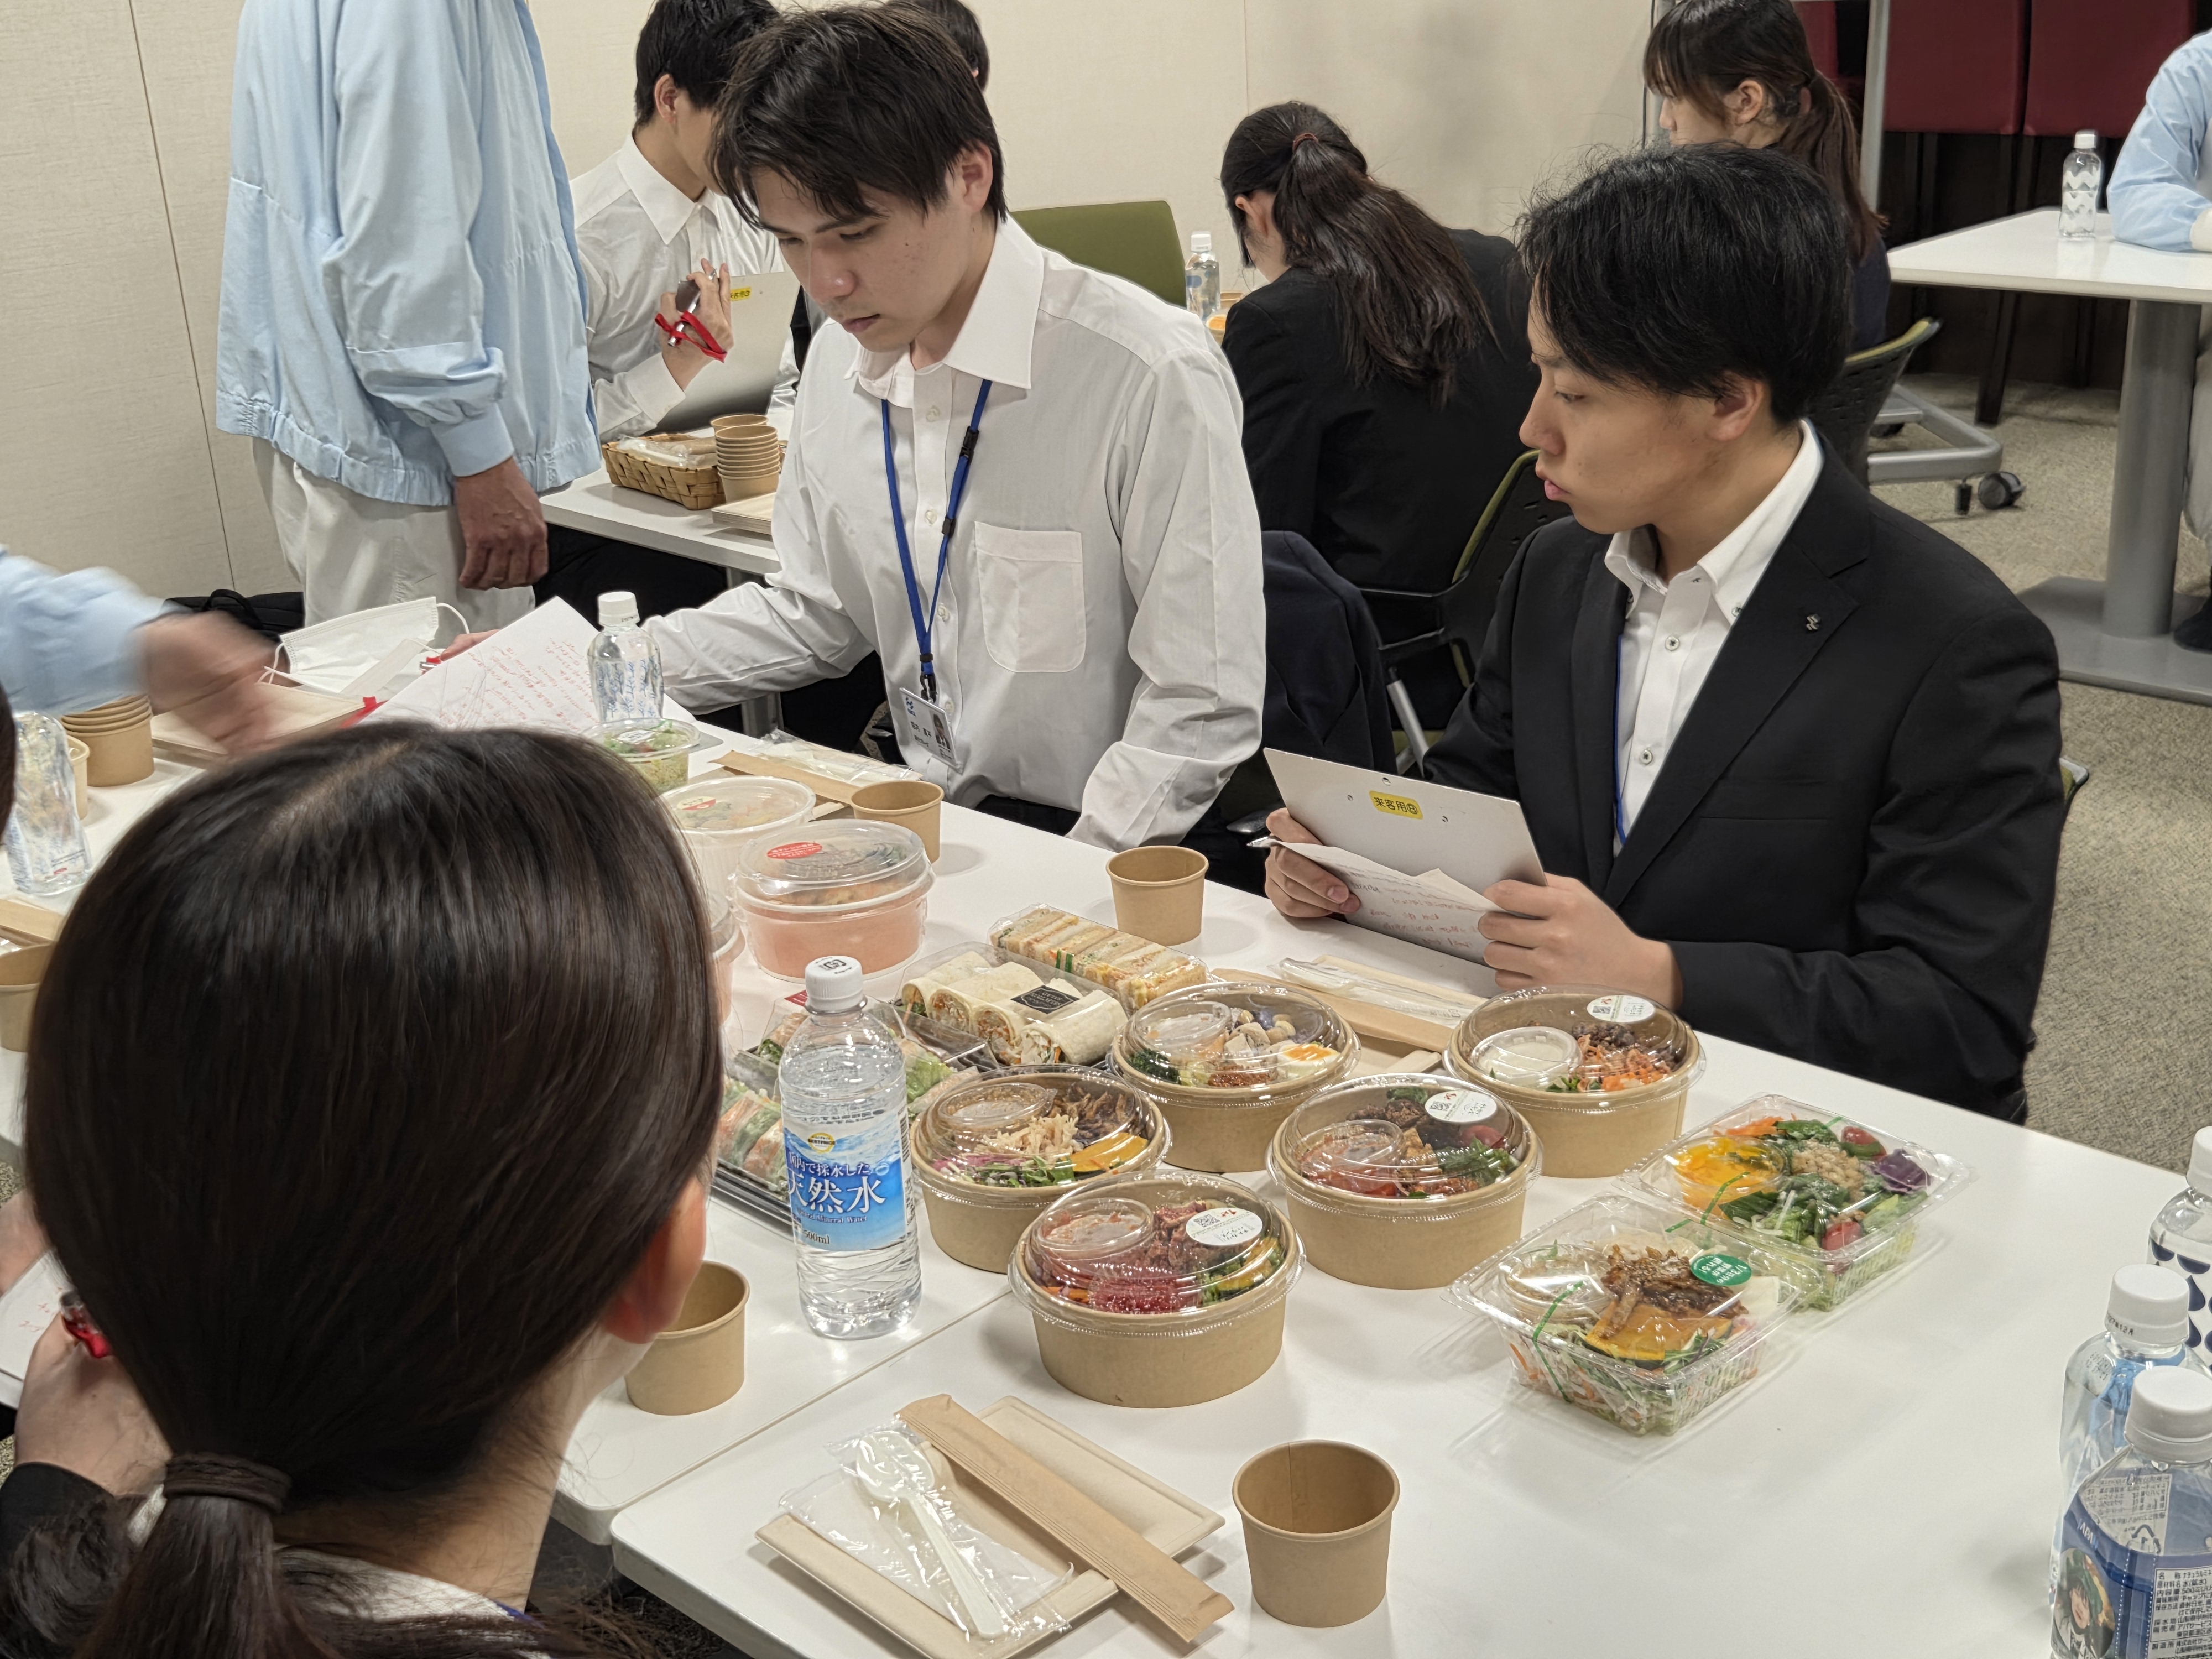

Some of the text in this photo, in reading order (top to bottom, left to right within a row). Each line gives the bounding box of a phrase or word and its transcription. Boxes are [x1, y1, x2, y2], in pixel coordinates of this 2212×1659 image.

[789, 1167, 886, 1213] 天然水
[804, 1229, 830, 1244] 500ml
